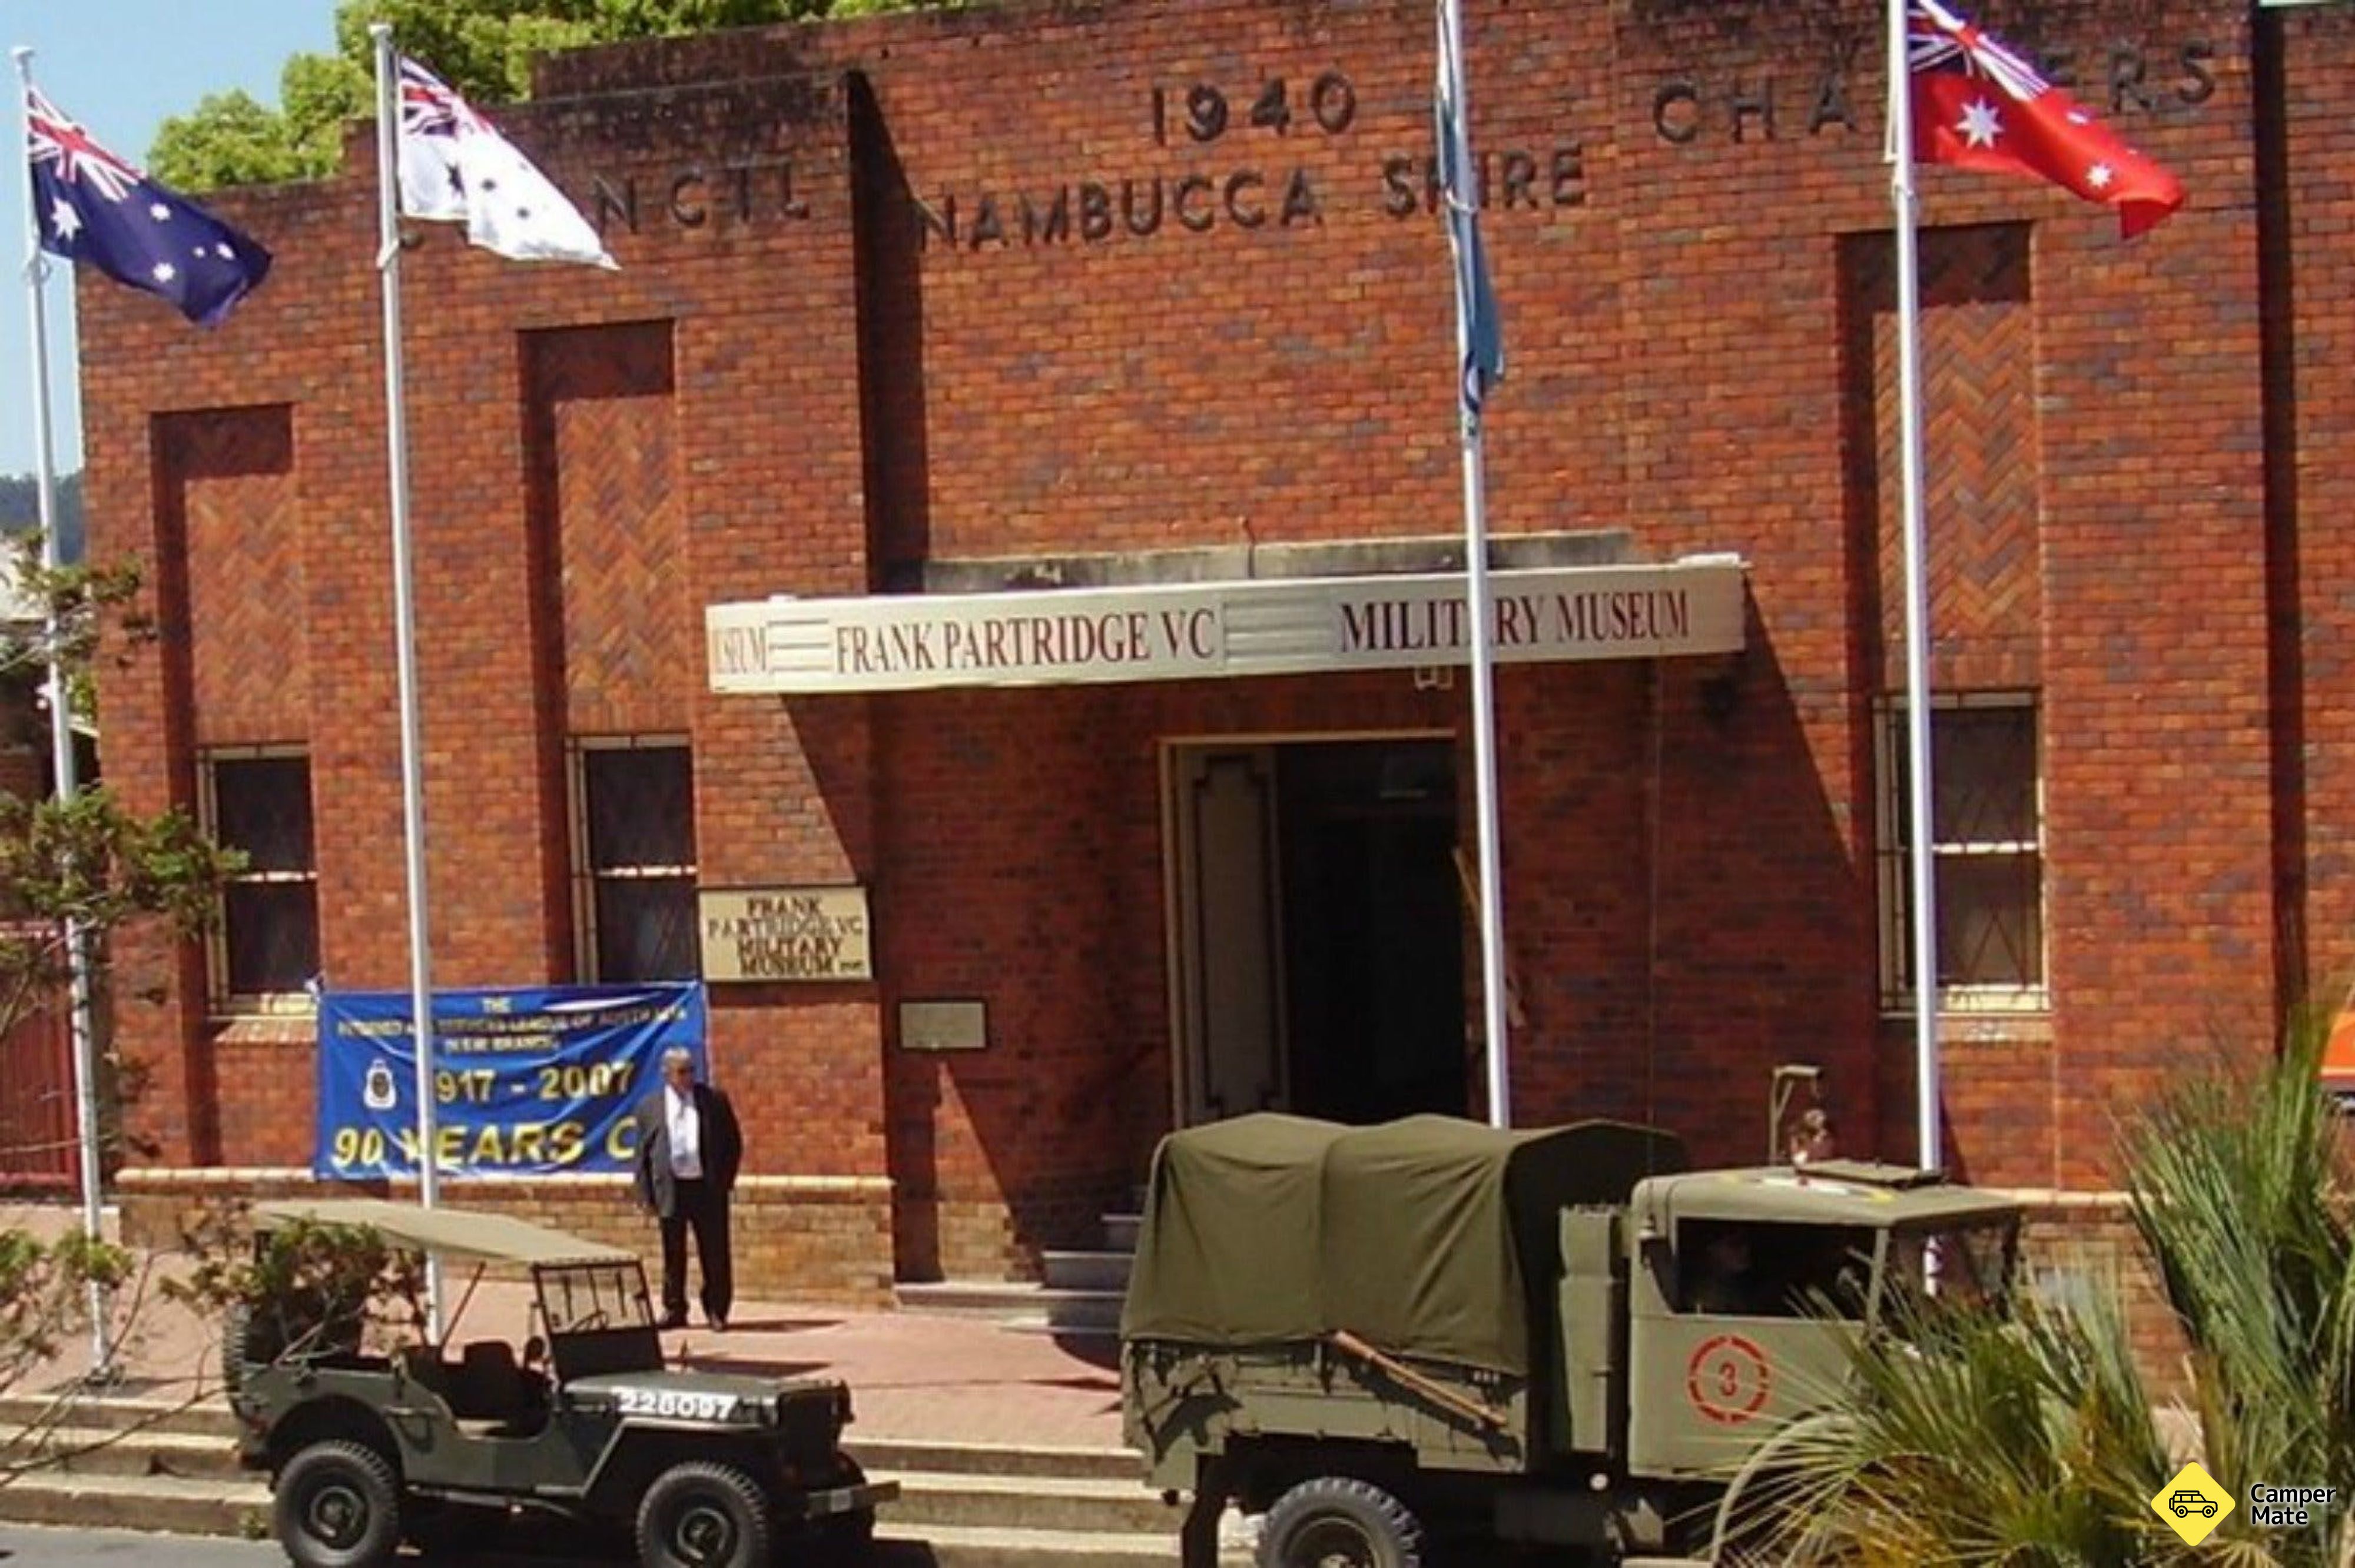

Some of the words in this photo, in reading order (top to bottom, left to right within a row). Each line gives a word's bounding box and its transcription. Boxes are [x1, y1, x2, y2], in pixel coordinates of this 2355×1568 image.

[1152, 70, 1356, 147] 1940
[915, 168, 1324, 252] NAMBUCCA
[837, 621, 935, 674] FRANK
[943, 611, 1150, 669] PARTRIDGE
[1160, 606, 1215, 660] VC
[1340, 594, 1544, 652] MILITRY
[1557, 589, 1690, 643] MUSEUM
[435, 1069, 496, 1102] 917
[539, 1060, 635, 1099] 2007
[334, 1127, 384, 1167] 90
[1719, 1361, 1737, 1397] 3
